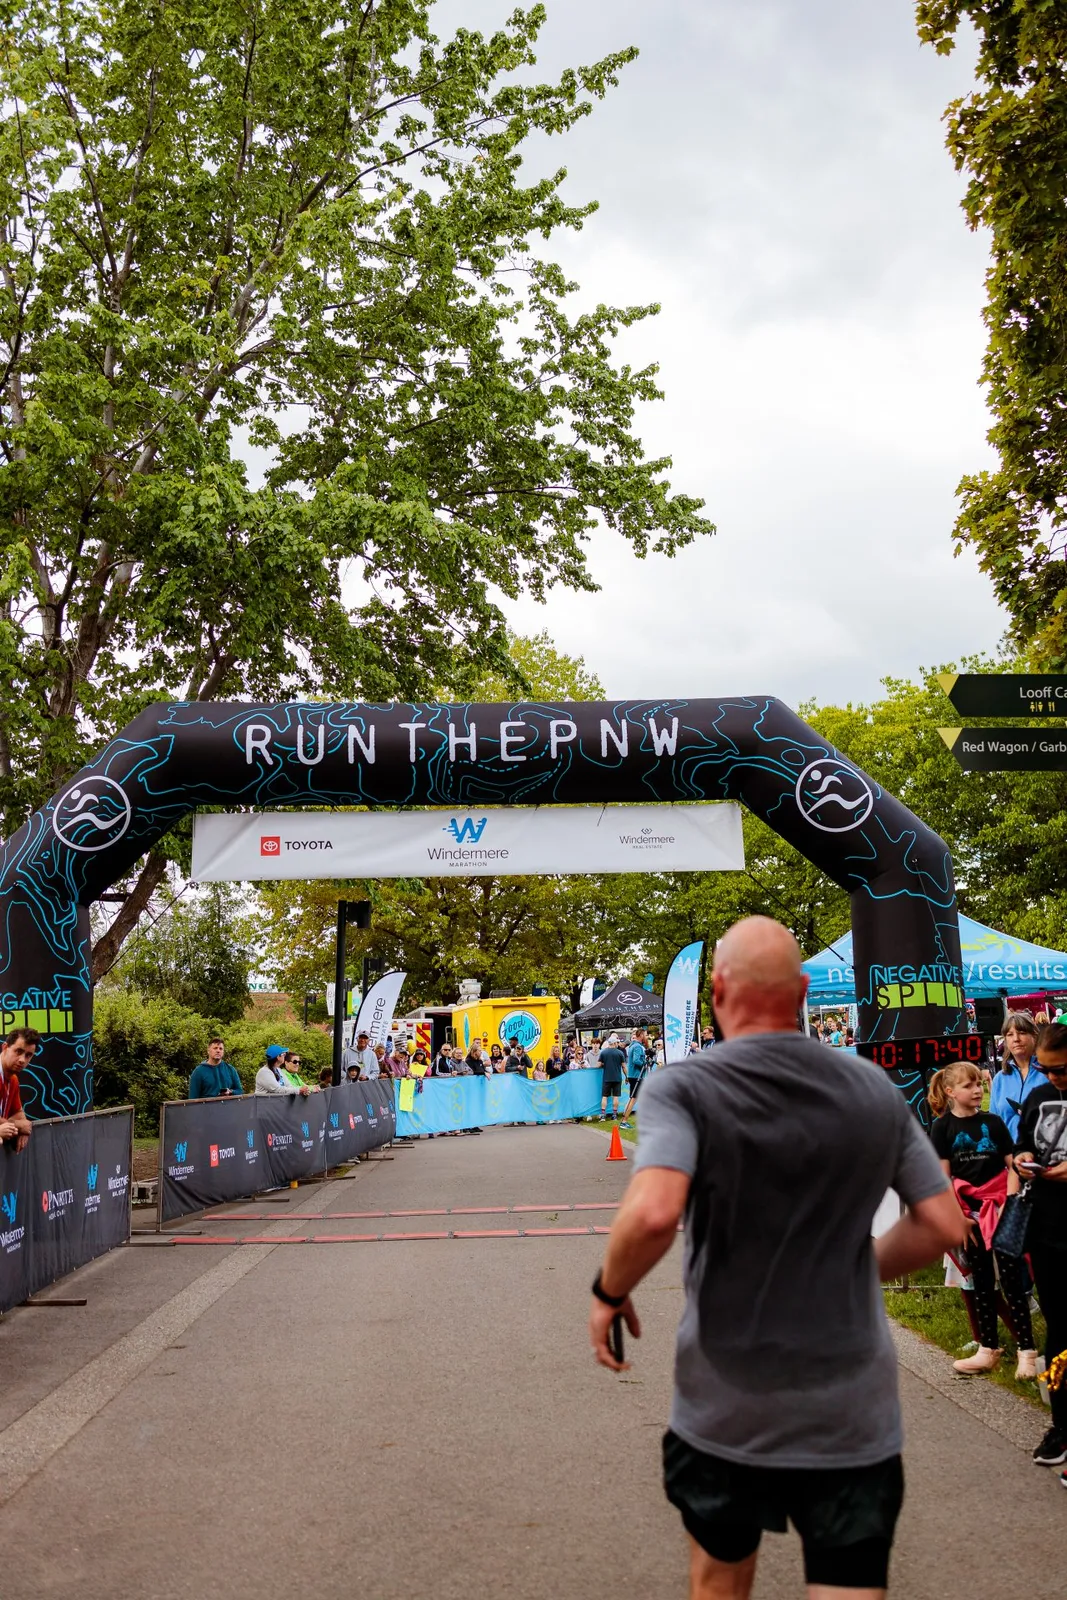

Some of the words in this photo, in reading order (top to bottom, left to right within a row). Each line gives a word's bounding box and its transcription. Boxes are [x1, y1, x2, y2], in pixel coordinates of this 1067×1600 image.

[1019, 686, 1052, 699] Looff
[962, 741, 985, 752] Red
[987, 741, 1029, 755] Wagon
[1031, 741, 1037, 753] /
[1039, 741, 1067, 752] Garb
[284, 840, 334, 851] TOYOTA
[618, 835, 675, 845] Windermere
[427, 847, 509, 860] Windermere
[874, 964, 961, 985] NEGATIVE
[966, 960, 1067, 982] /results
[0, 990, 73, 1011] GATIVE
[498, 1014, 526, 1040] Good
[872, 1034, 982, 1069] 10:17:40
[218, 1147, 236, 1160] TOYOTA
